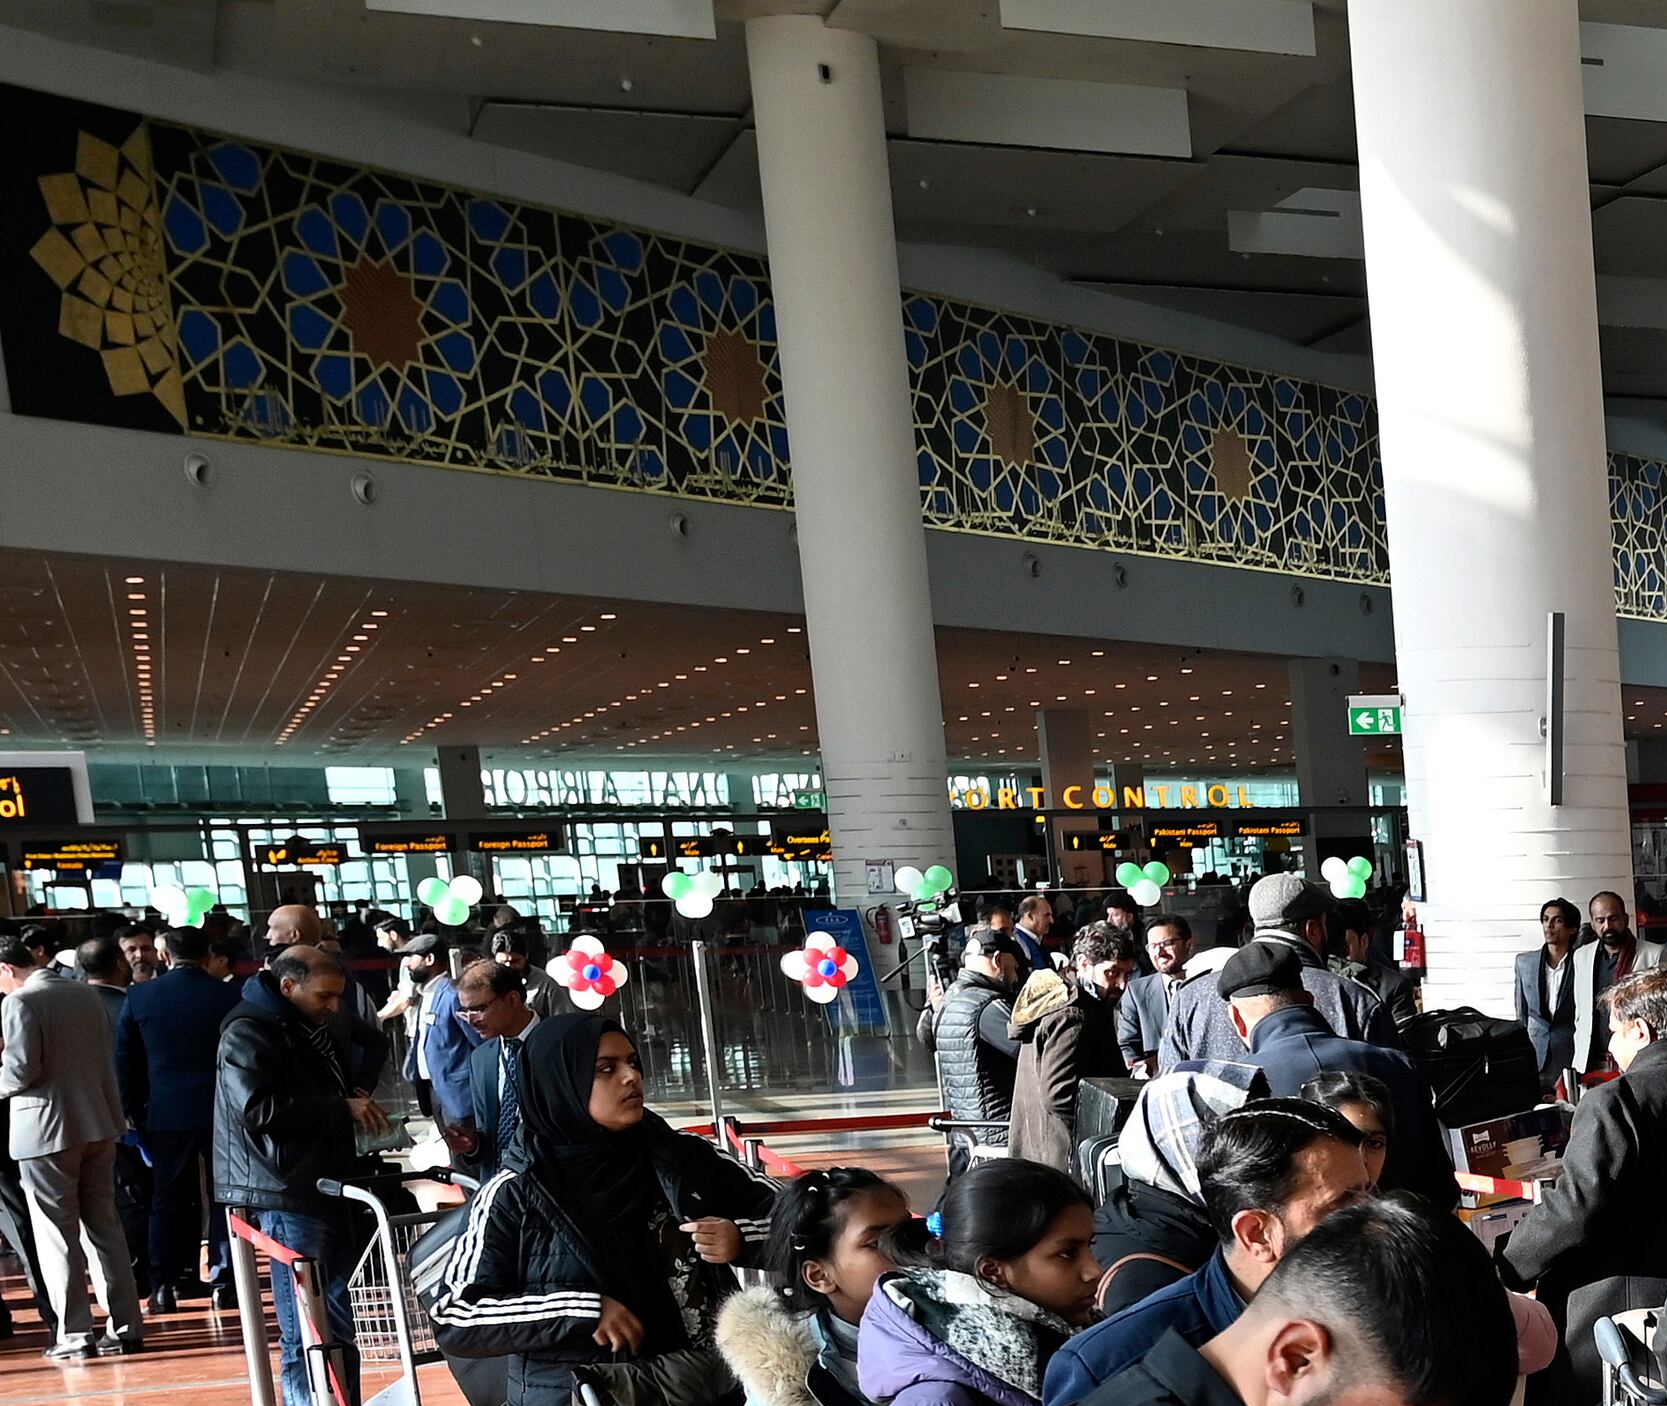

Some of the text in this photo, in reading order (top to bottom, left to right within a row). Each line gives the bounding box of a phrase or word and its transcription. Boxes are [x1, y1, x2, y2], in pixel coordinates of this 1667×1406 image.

[1063, 785, 1255, 810] CONTROL
[1154, 828, 1186, 836] Pakistani
[478, 840, 548, 850] Foreign Passport
[787, 836, 819, 844] Overseas
[375, 841, 447, 851] Foreign Passport
